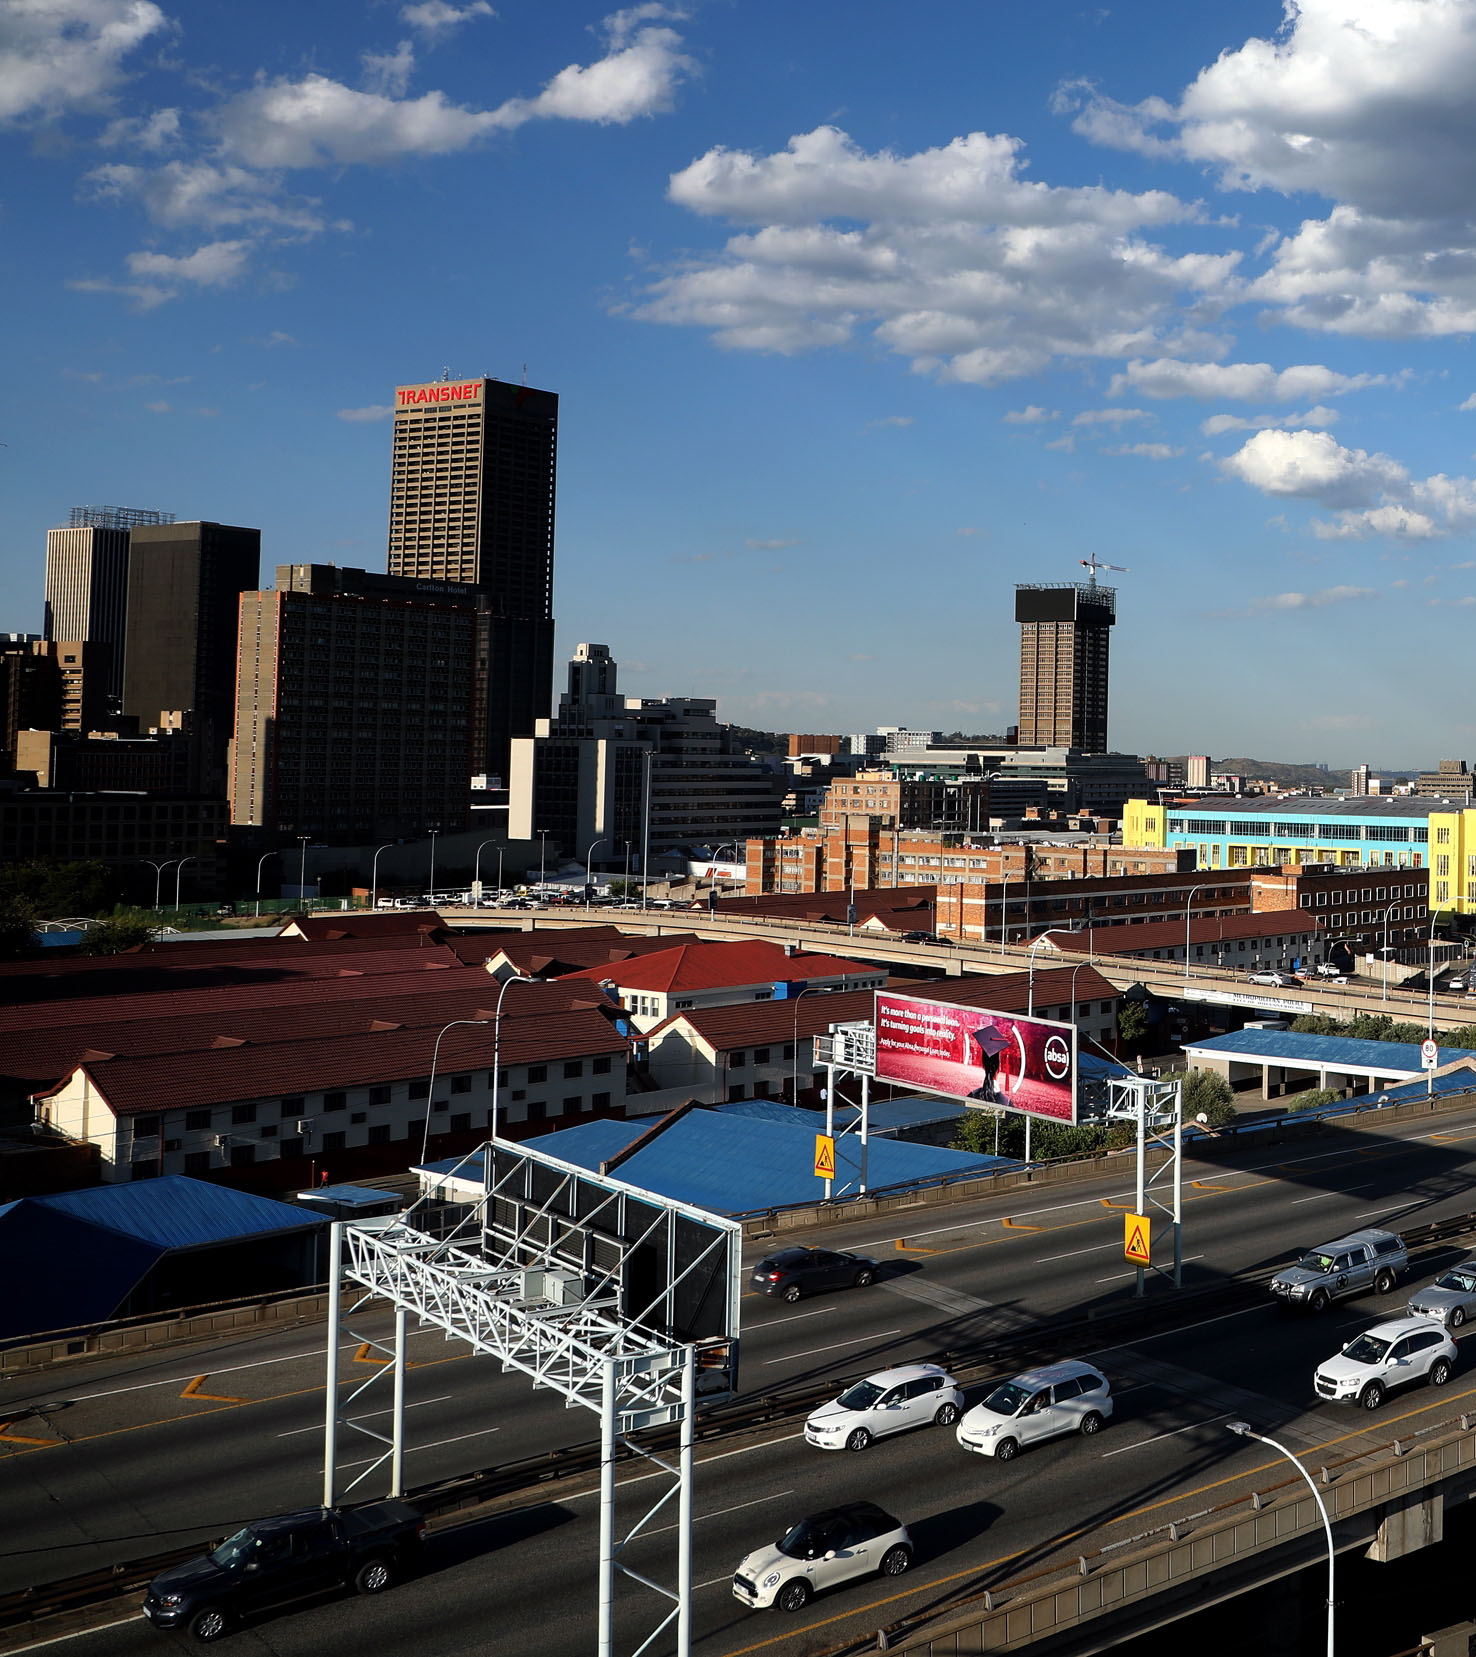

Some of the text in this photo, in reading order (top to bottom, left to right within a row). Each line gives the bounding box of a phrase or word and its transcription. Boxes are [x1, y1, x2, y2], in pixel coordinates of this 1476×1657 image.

[396, 383, 482, 405] TRANSNET
[416, 582, 444, 592] Carlton
[881, 1005, 890, 1015] It's
[890, 1009, 904, 1017] more
[904, 1009, 917, 1019] than
[922, 1014, 946, 1024] personal
[881, 1018, 956, 1041] It's turning goals into reality.
[880, 1038, 891, 1048] Apply
[1425, 1044, 1433, 1052] 80
[1047, 1047, 1067, 1064] absa
